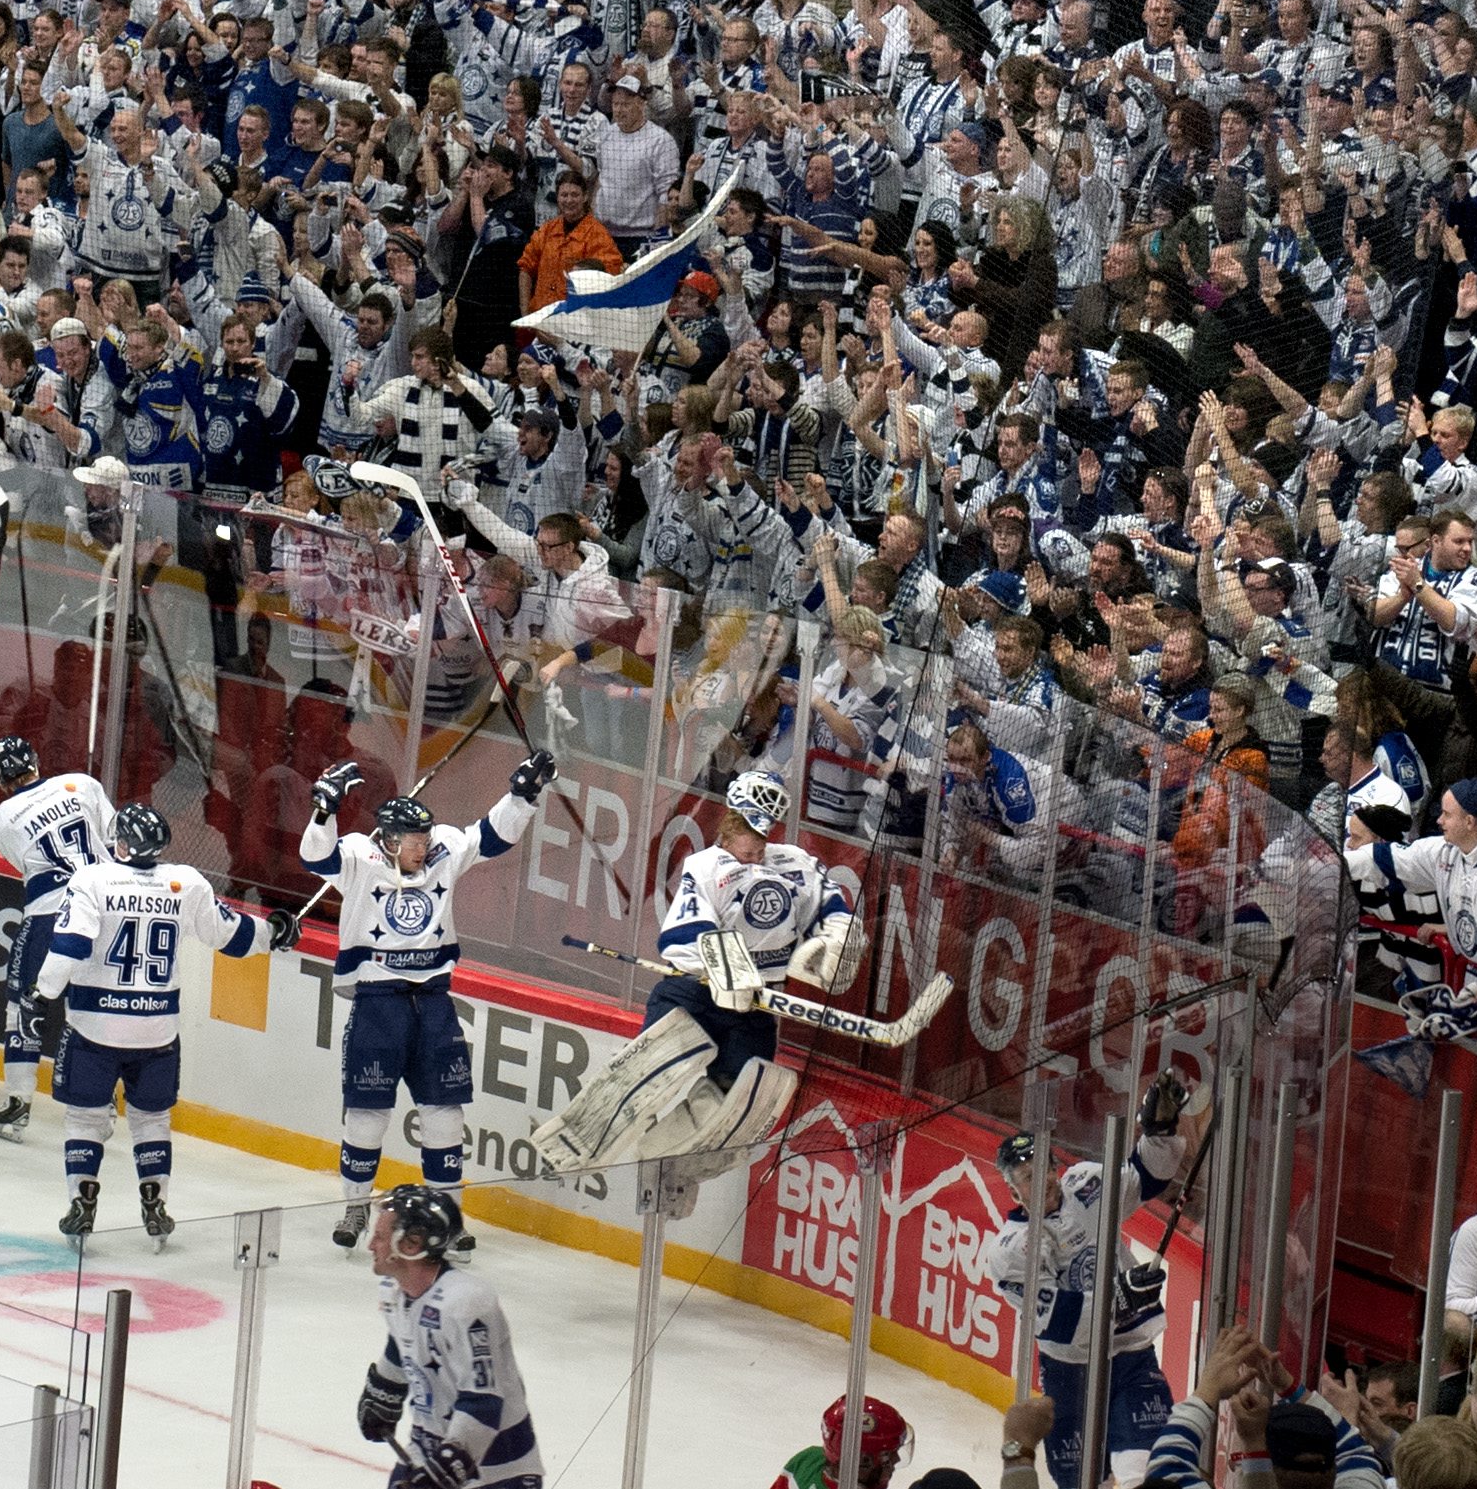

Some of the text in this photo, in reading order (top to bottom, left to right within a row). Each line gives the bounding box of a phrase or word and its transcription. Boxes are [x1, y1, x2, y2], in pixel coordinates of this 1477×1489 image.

[351, 614, 415, 655] LEKS
[35, 817, 99, 873] 17
[104, 894, 182, 916] KARLSSON
[104, 917, 180, 986] 49
[99, 995, 129, 1011] clas
[768, 994, 875, 1040] Reebok
[778, 1159, 862, 1231] BRA
[772, 1216, 860, 1300] HUS
[917, 1269, 1003, 1359] HUS
